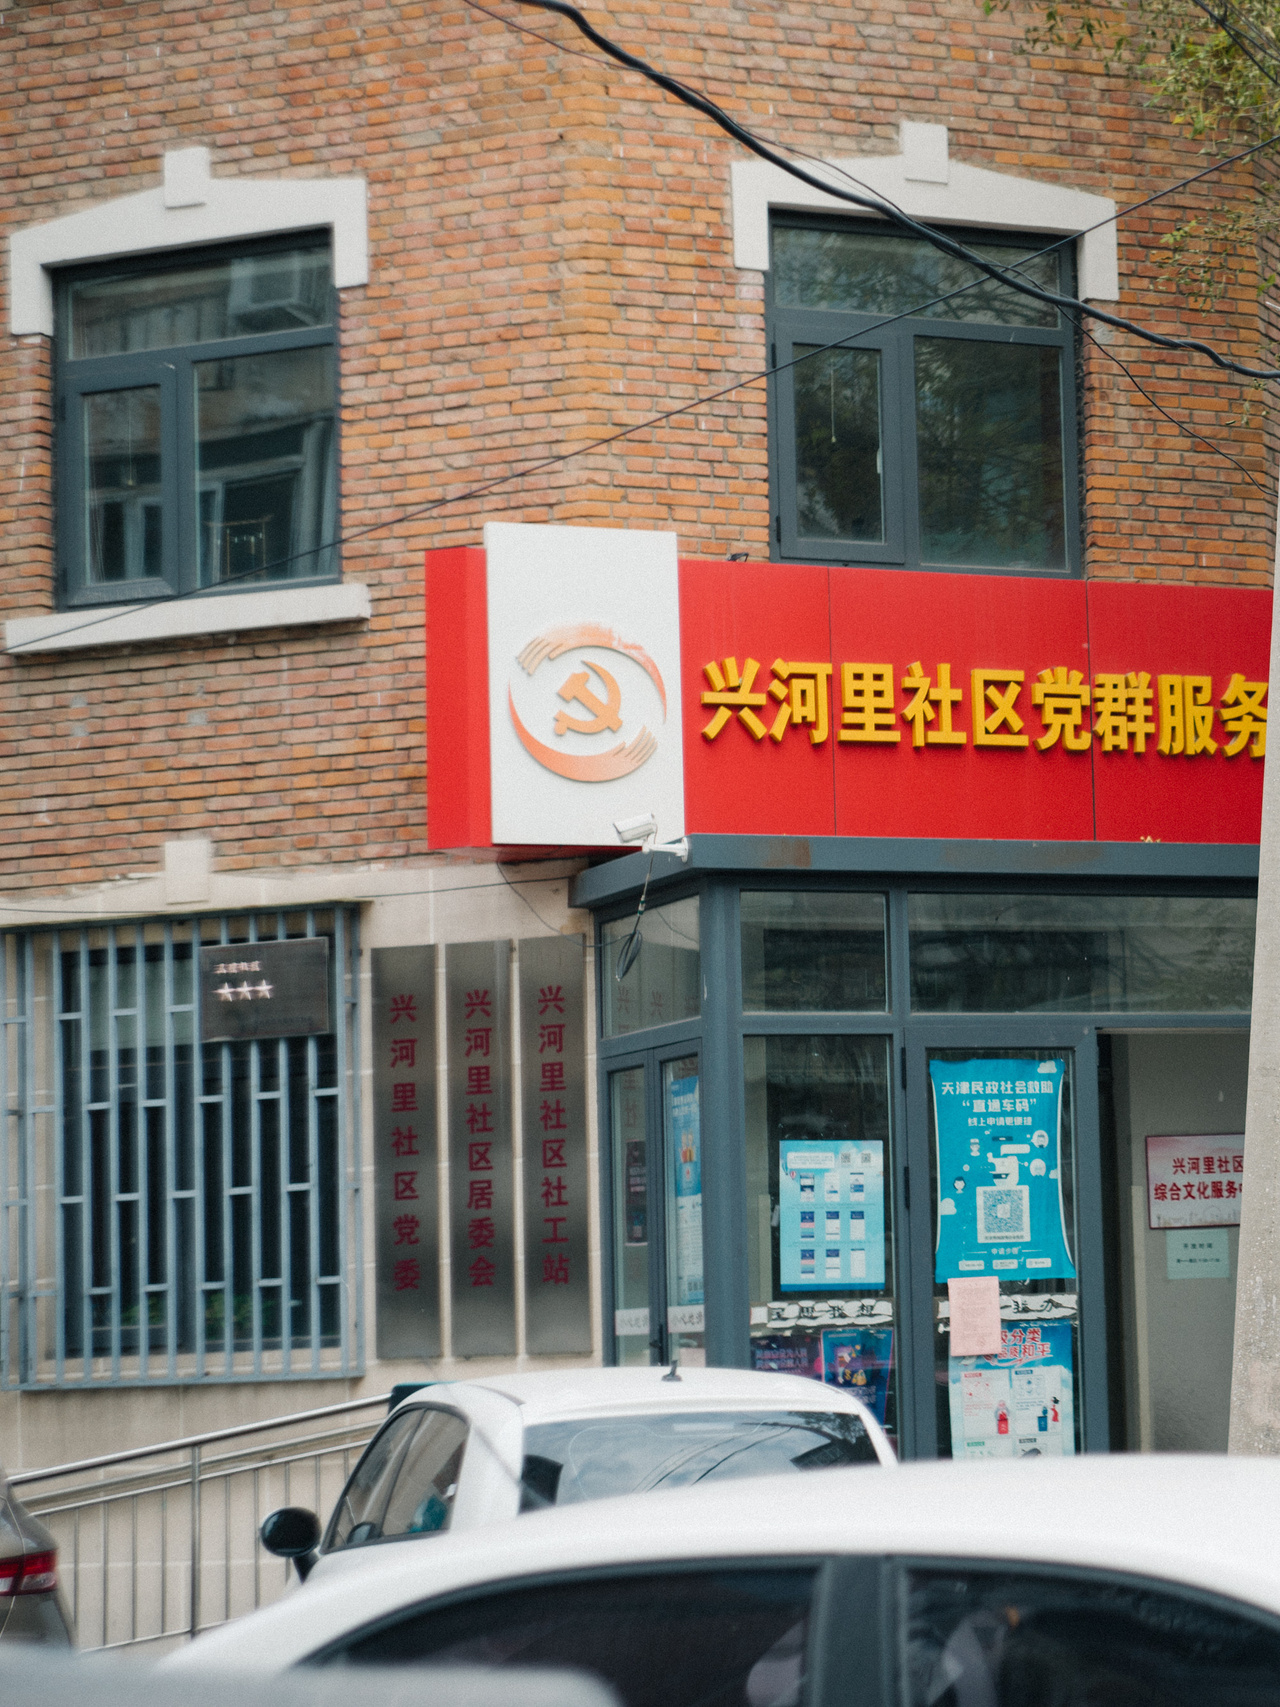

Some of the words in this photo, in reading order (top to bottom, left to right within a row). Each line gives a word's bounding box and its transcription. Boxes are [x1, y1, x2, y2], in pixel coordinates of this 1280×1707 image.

[390, 994, 420, 1292] 兴河里社区党委
[464, 989, 496, 1288] 兴河里社区居委会
[538, 985, 570, 1286] 兴河里社区社工站
[941, 1081, 1053, 1095] 天津民政社会救助
[1154, 1180, 1242, 1201] 综合文化服务
